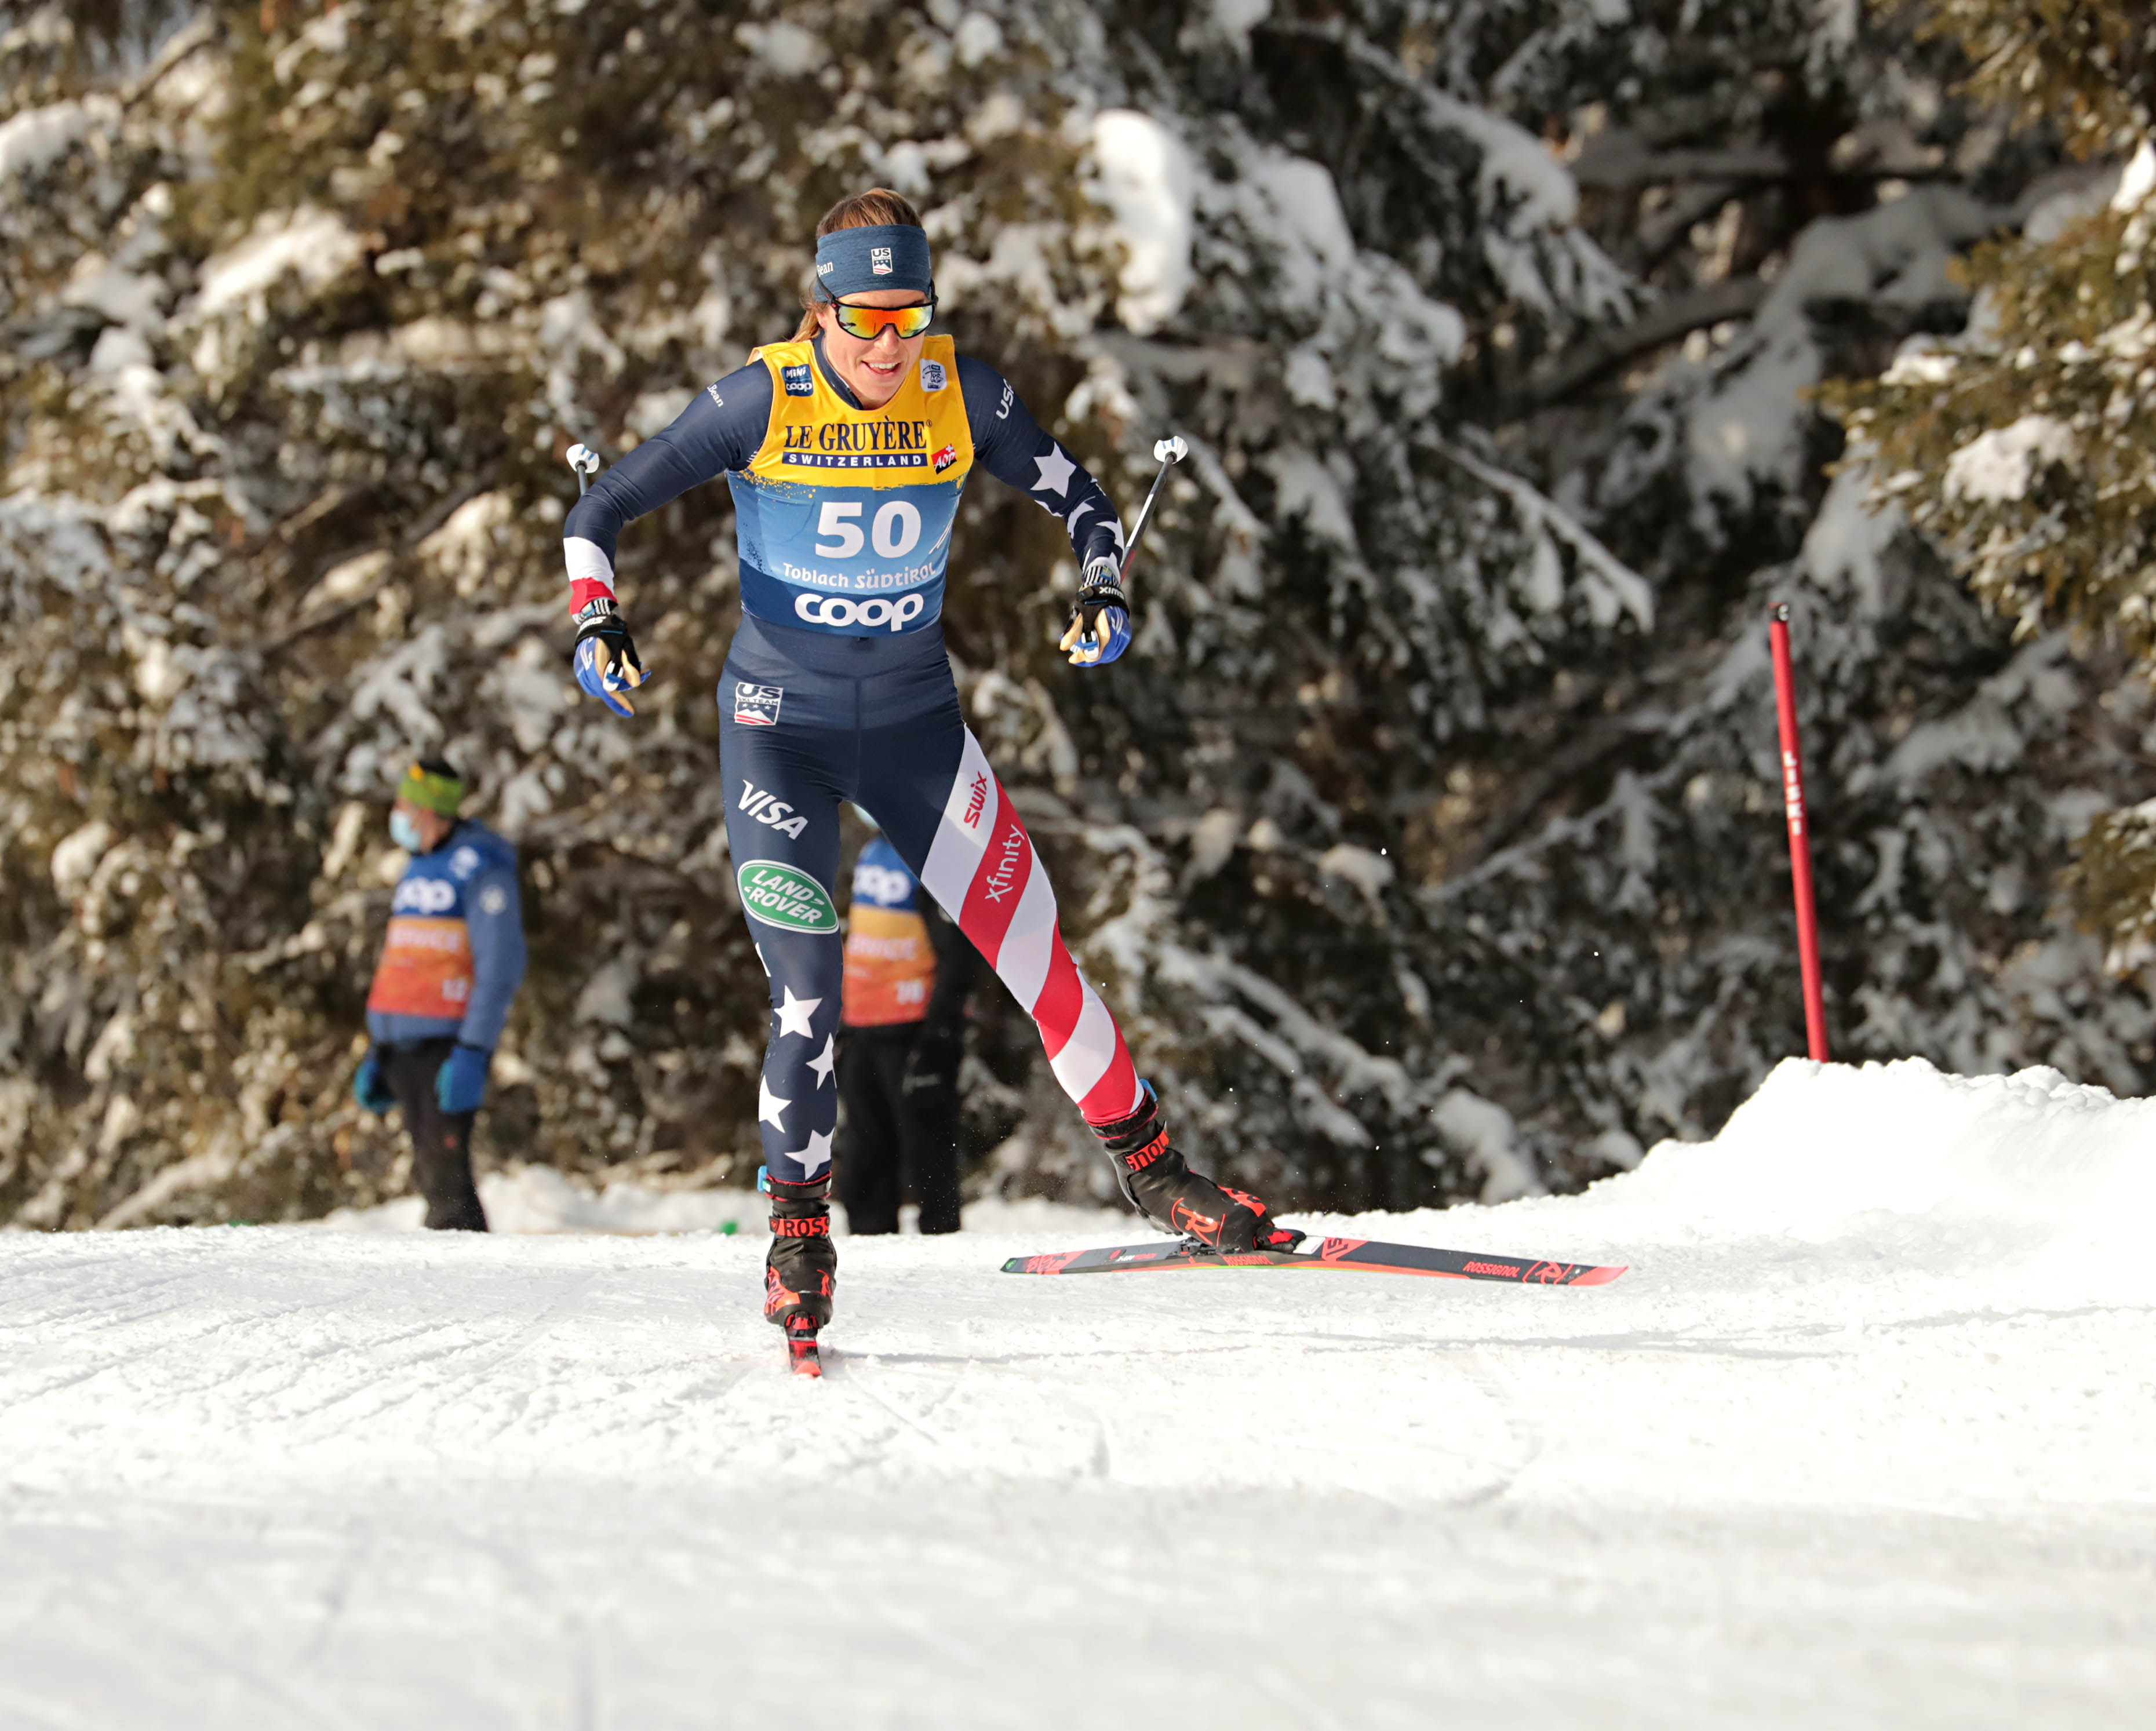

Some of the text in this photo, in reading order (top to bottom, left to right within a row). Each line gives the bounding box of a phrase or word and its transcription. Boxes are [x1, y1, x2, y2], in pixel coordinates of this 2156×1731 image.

[872, 249, 890, 257] US
[786, 382, 813, 392] coop
[784, 425, 813, 449] LE
[788, 453, 922, 467] SWITZERLAND
[934, 451, 956, 471] AOP
[815, 500, 922, 559] 50
[783, 562, 848, 588] Toblach
[795, 593, 924, 632] coop
[737, 684, 781, 699] US
[738, 779, 808, 840] VISA
[964, 770, 987, 829] swix
[1463, 1261, 1521, 1277] ROSSIGNOL
